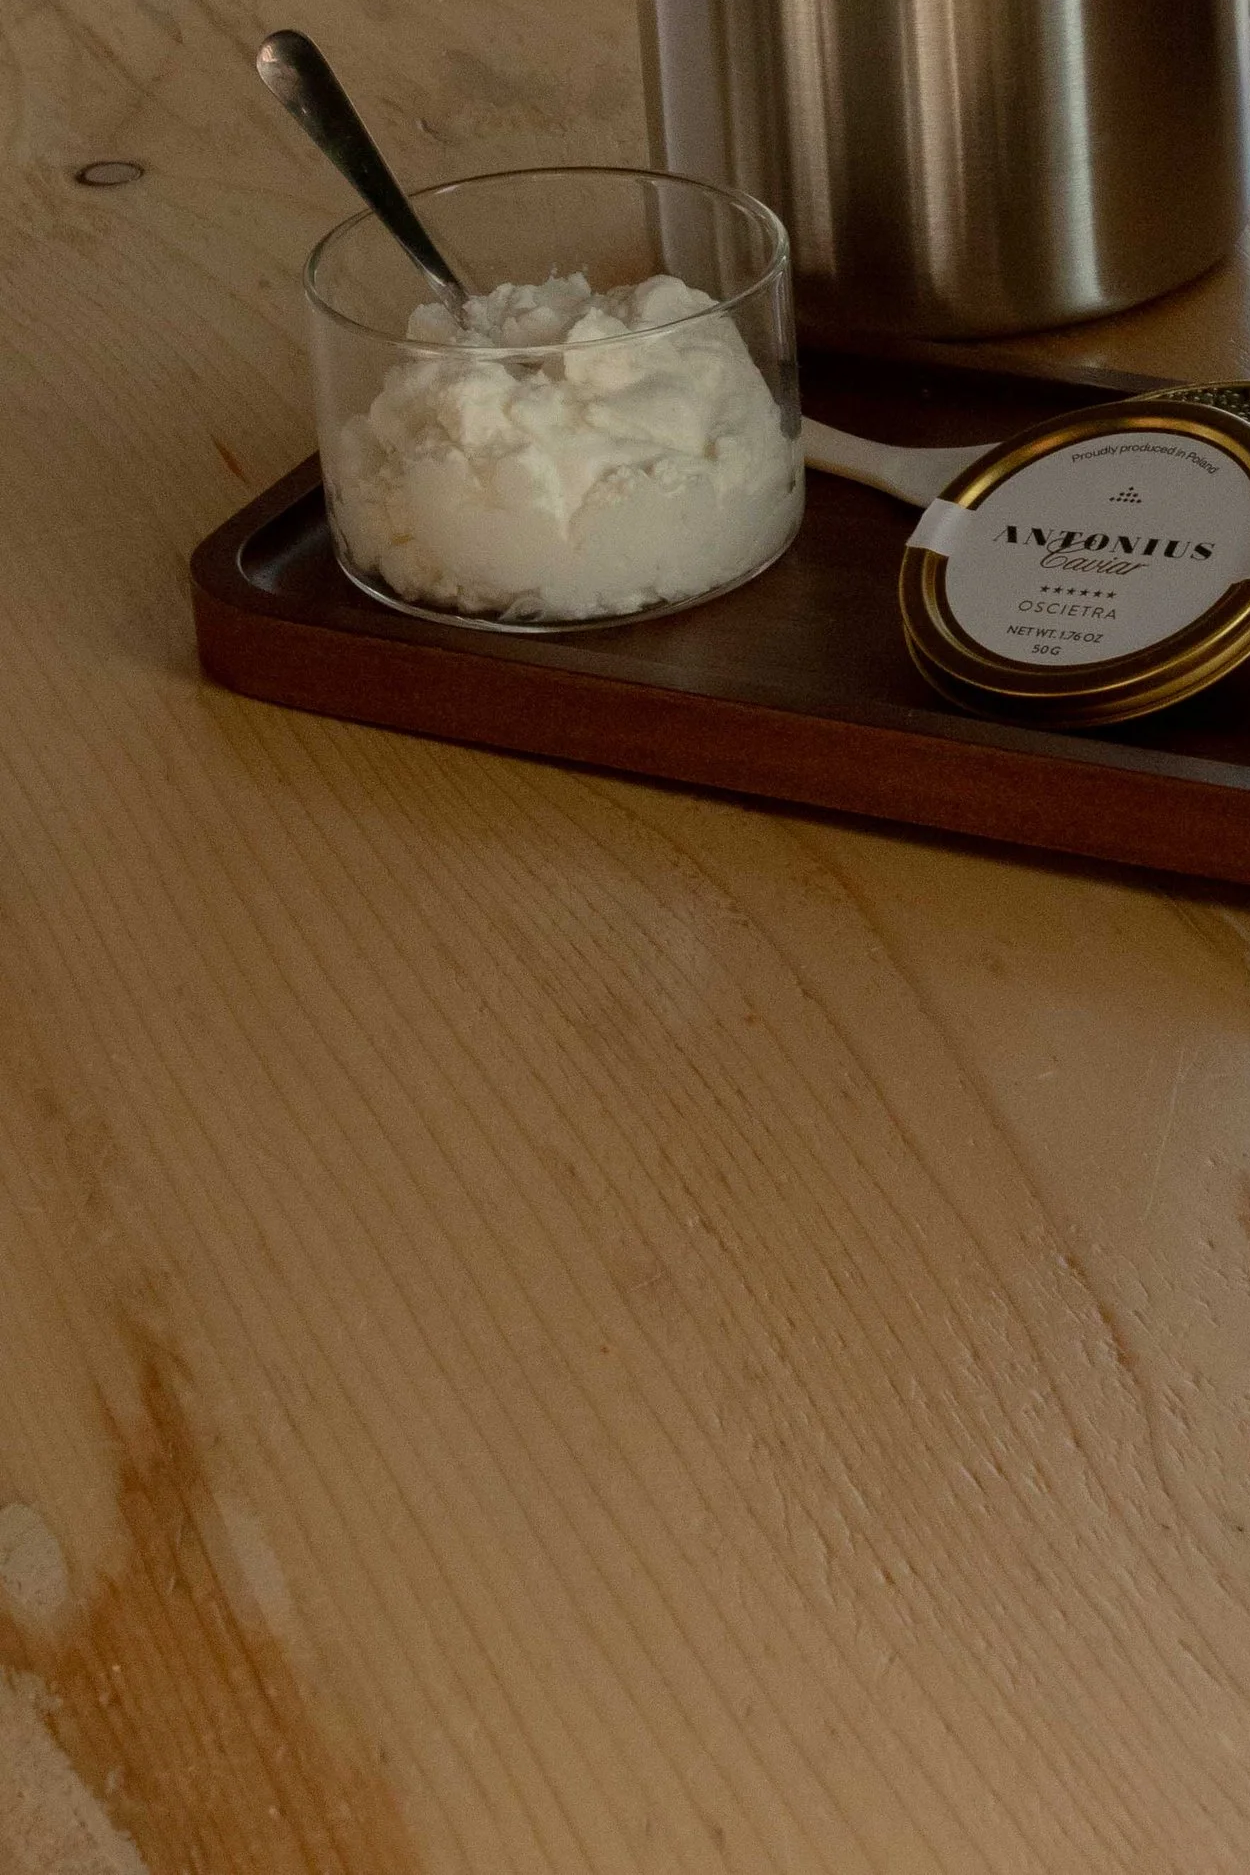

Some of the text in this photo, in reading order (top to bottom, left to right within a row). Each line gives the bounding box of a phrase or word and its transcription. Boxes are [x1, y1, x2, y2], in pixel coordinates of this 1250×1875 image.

[1072, 443, 1220, 474] Proudly produced in Poland
[992, 525, 1216, 562] ANTONIUS
[1039, 535, 1149, 576] Caviar
[1018, 600, 1117, 619] OSCIETRA
[1006, 625, 1104, 644] NET WT. 1.76 OZ
